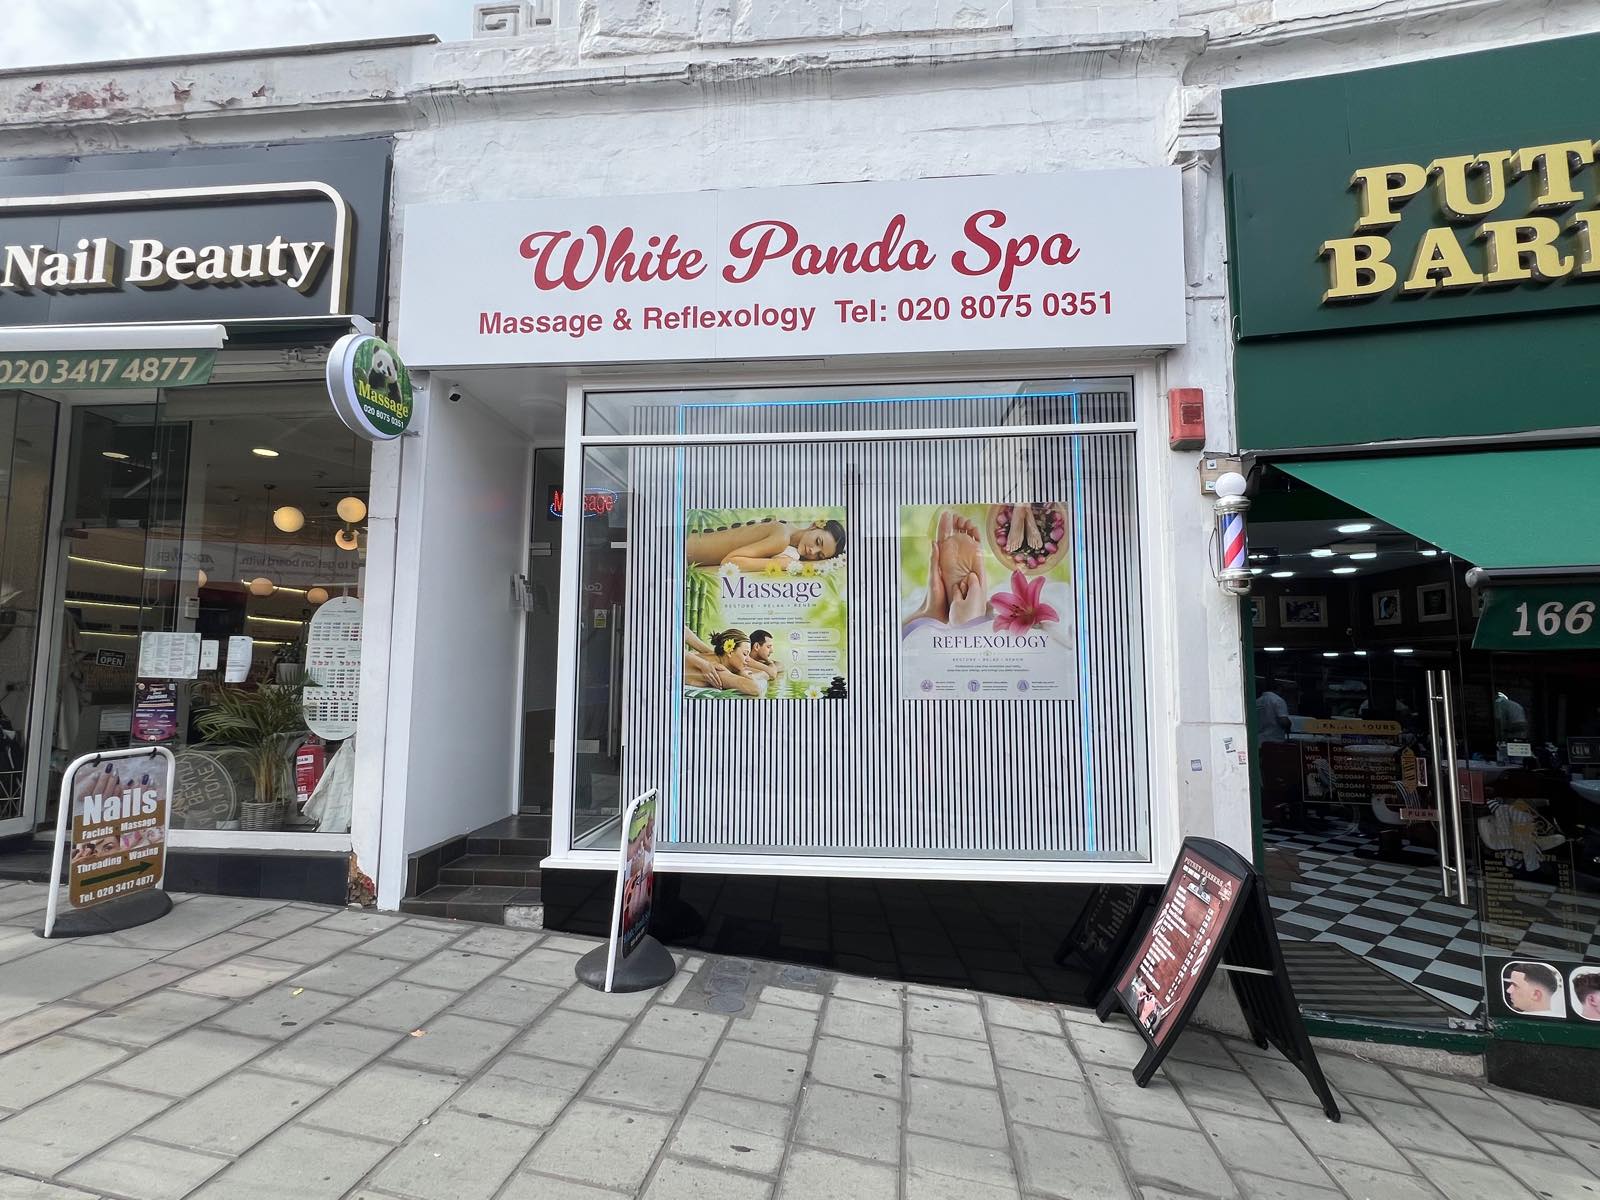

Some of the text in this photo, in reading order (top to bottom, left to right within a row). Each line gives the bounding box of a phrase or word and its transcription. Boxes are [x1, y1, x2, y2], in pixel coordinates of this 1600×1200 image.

[1352, 140, 1600, 226] PUT
[1, 235, 326, 288] Nail Beauty
[519, 209, 1079, 291] White Panda Spa
[479, 291, 1111, 337] Massage & Reflexology Tel: 020 8075 0351
[51, 357, 118, 384] 3417
[121, 355, 198, 383] 4877
[358, 379, 409, 419] Massage
[363, 404, 375, 416] 020
[376, 409, 391, 423] 8075
[721, 576, 822, 603] Massage
[1512, 600, 1596, 636] 166
[932, 635, 1049, 649] REFLEXOLOGY
[100, 656, 123, 666] OPEN
[1362, 723, 1396, 731] OURS
[83, 787, 158, 826] Nails
[82, 817, 157, 840] Facials Massage
[77, 846, 159, 874] Threading Waxing
[79, 891, 96, 904] Tel.
[97, 885, 114, 898] 020
[115, 881, 135, 894] 3417
